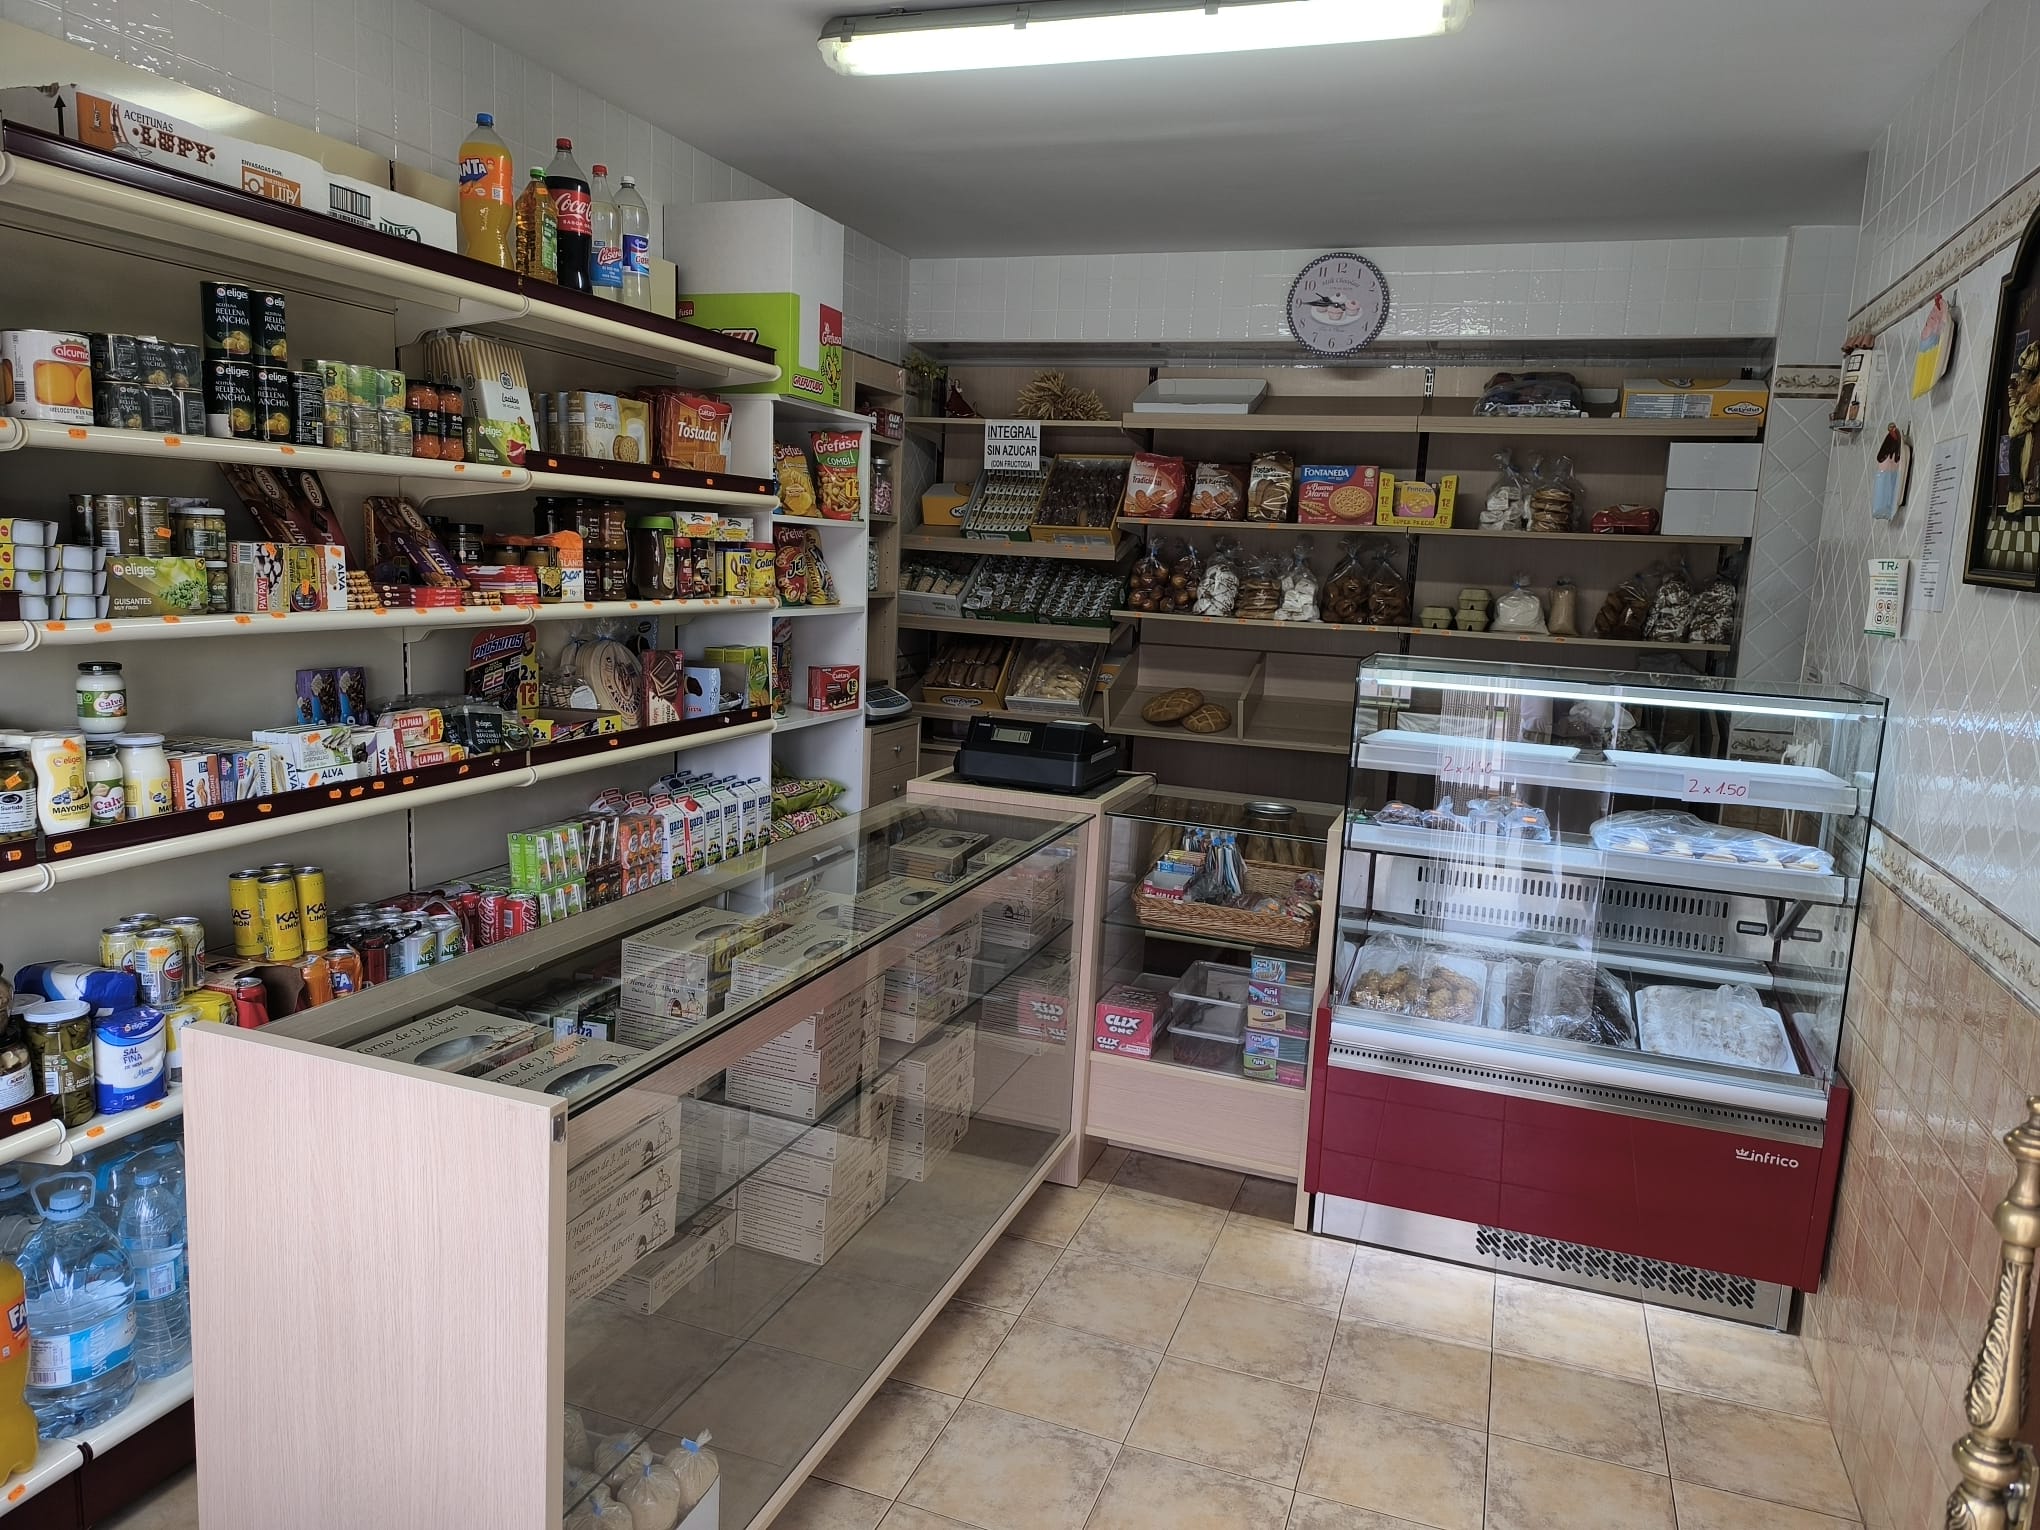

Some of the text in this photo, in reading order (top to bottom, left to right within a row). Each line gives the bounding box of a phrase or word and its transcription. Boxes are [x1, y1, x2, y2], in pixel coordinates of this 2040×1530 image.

[124, 109, 173, 133] ACEITUNAS
[139, 124, 215, 165] LUPY
[1319, 267, 1328, 278] 11
[1337, 262, 1348, 274] 12
[1304, 280, 1317, 291] 10
[1369, 281, 1376, 292] 2
[227, 288, 248, 299] eliges
[215, 307, 246, 317] RELLENA
[679, 306, 693, 316] fusa
[217, 316, 250, 326] ANCHOA
[265, 323, 285, 332] ANCH
[821, 331, 842, 345] Grefusa
[1312, 332, 1318, 343] 7
[1328, 337, 1335, 349] 6
[226, 366, 250, 377] eliges
[215, 386, 245, 394] RELLENA
[258, 391, 285, 399] RELLENA
[216, 393, 251, 402] ANCHOA
[678, 421, 717, 442] Tostada
[987, 425, 1037, 439] INTEGRAL
[775, 443, 805, 460] Grefus
[815, 438, 859, 453] Grefusa
[987, 445, 1037, 456] SIN AZUCAR
[991, 460, 1032, 469] (CON FRUCTOSA)
[1304, 468, 1349, 477] FONTANEDA
[257, 469, 278, 498] VALOR
[304, 476, 320, 505] VALOR
[402, 504, 421, 528] VALOR
[778, 527, 805, 542] Grefus
[427, 546, 456, 576] LECHE
[124, 563, 155, 578] eliges
[337, 563, 345, 591] ALVA
[114, 597, 152, 605] GUISANTES
[259, 579, 268, 610] PAY PAY
[473, 633, 524, 660] PHOSKITOS
[98, 696, 124, 709] Calvé
[400, 717, 422, 728] LA PIARA
[420, 753, 443, 764] LA PIARA
[286, 762, 298, 789] ALVA
[321, 767, 344, 779] ALVA
[1688, 778, 1699, 794] 2
[1717, 782, 1747, 798] 1.50
[742, 800, 755, 813] gaza
[758, 795, 770, 808] gaza
[706, 808, 720, 821] gaza
[724, 803, 737, 818] gaza
[670, 819, 683, 835] gaza
[690, 815, 703, 831] gaza
[397, 1031, 410, 1041] de
[427, 1010, 469, 1032] Alberto
[1105, 1014, 1141, 1029] CLIX
[407, 1025, 459, 1048] Tradicionales
[1097, 1036, 1120, 1046] CLIX
[124, 1047, 138, 1056] SAL
[521, 1061, 534, 1071] de
[548, 1037, 588, 1058] Alberto
[123, 1054, 143, 1064] FINA
[578, 1166, 600, 1187] Horno
[601, 1158, 610, 1170] de
[619, 1138, 642, 1158] Alberto
[1751, 1150, 1799, 1168] infrico
[597, 1208, 606, 1219] de
[615, 1187, 640, 1208] Alberto
[593, 1254, 601, 1268] de
[611, 1232, 636, 1253] Alberto
